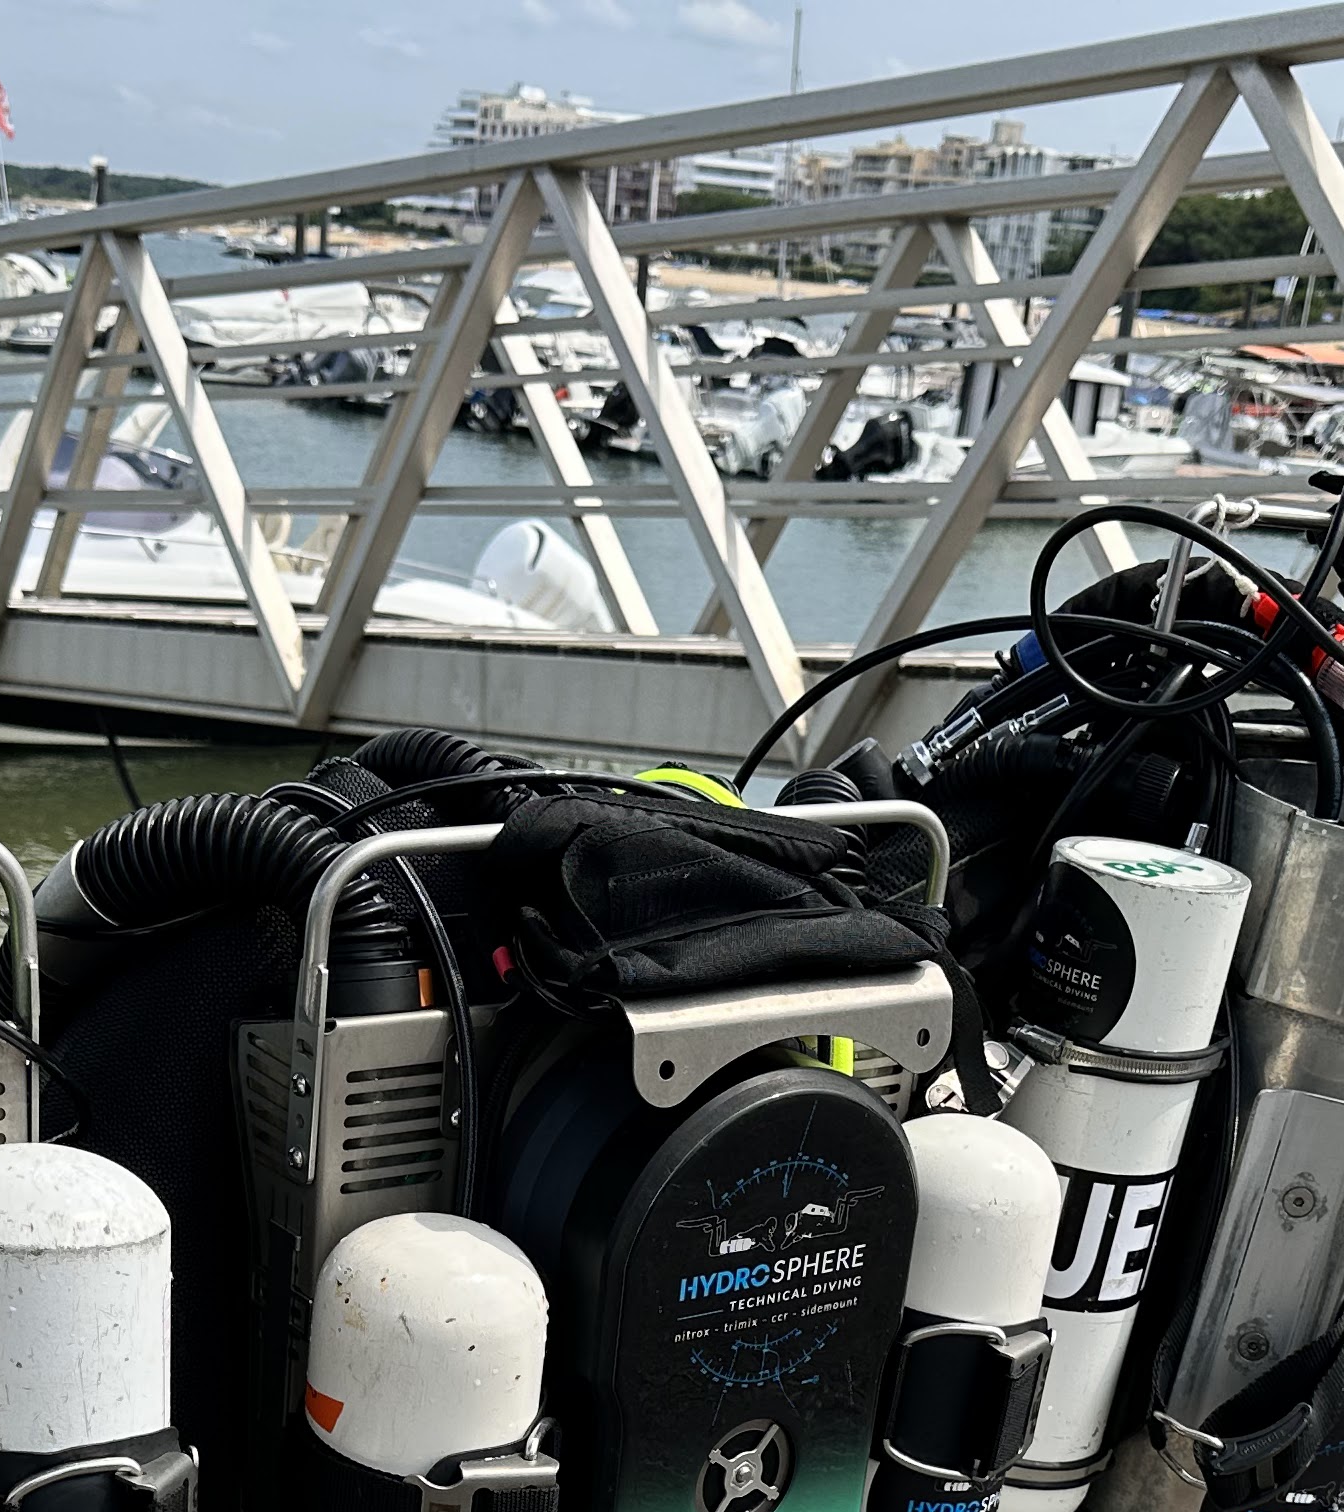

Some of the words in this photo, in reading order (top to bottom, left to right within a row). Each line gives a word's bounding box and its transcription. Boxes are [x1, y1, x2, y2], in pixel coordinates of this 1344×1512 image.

[679, 1243, 867, 1301] HYDROSPHERE
[729, 1287, 808, 1312] TECHNICAL
[812, 1276, 862, 1296] DIVING
[674, 1327, 710, 1343] nitrox
[723, 1317, 758, 1333] trimix
[771, 1312, 789, 1323] ccr
[801, 1297, 858, 1317] sidemount
